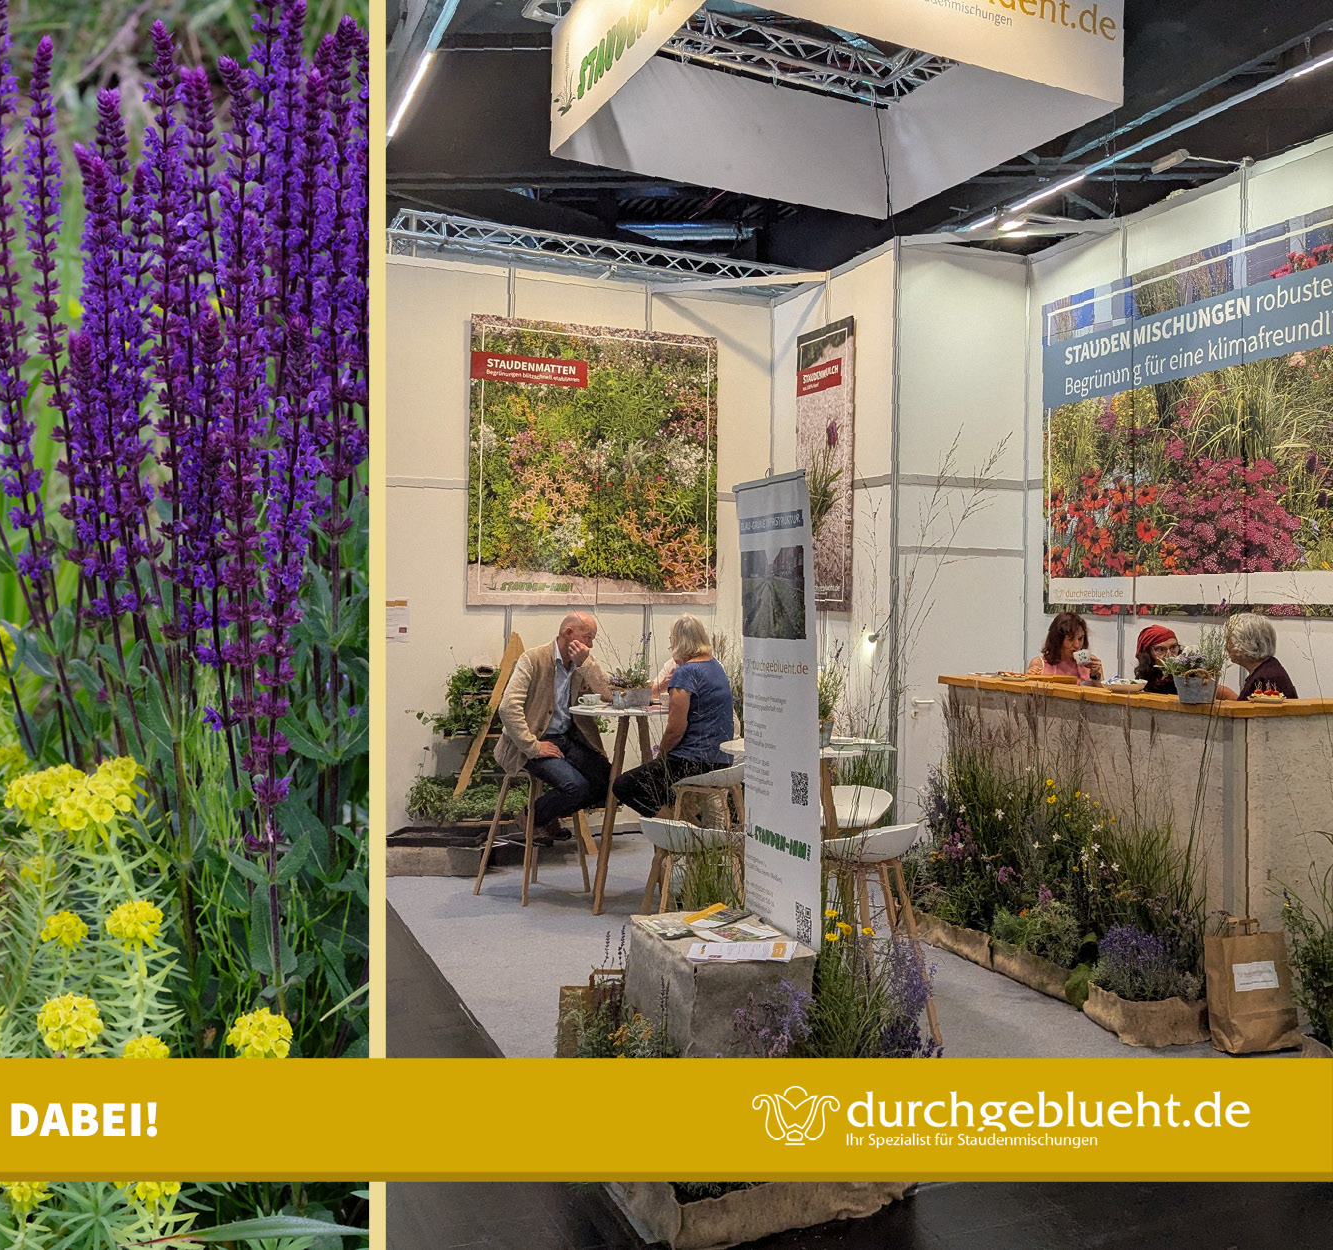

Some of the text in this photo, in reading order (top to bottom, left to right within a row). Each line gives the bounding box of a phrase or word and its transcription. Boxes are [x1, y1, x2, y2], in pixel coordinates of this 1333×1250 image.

[1256, 277, 1333, 313] robuste
[1144, 355, 1167, 377] für
[1169, 347, 1204, 371] eine
[1208, 309, 1333, 362] klimafreundl
[486, 358, 576, 375] STAUDENMATTEN
